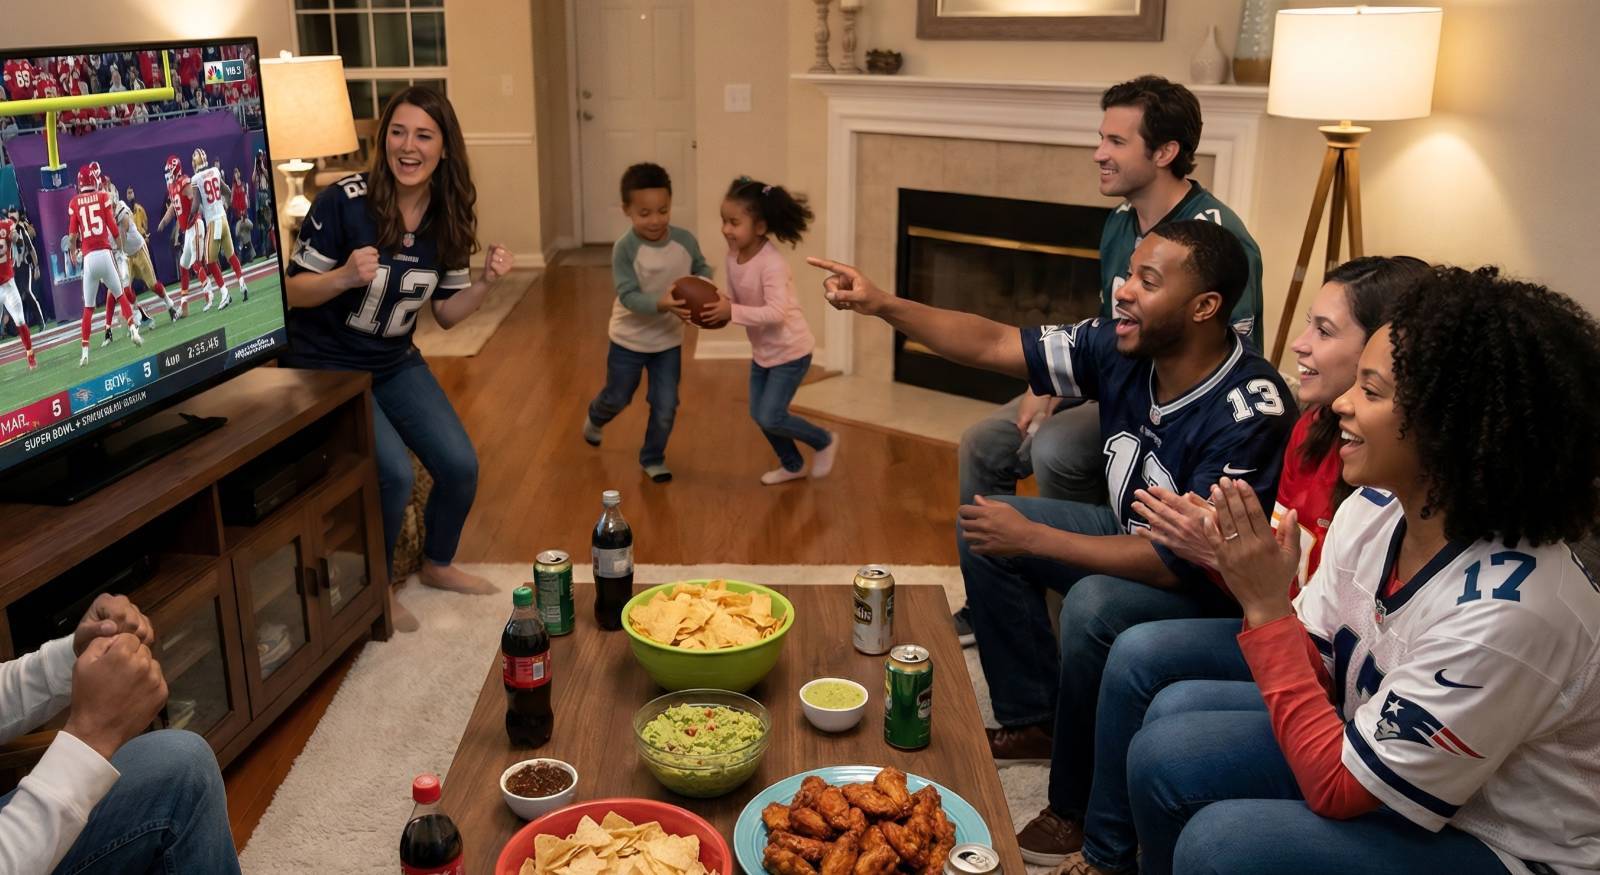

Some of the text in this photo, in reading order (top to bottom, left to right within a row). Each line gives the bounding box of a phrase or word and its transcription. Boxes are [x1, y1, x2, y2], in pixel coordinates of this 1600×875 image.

[79, 203, 104, 239] 15
[345, 264, 440, 338] 12
[52, 399, 62, 417] 5
[1227, 378, 1286, 423] 13
[24, 431, 52, 452] SUPER
[52, 422, 76, 441] BOWL
[1456, 550, 1537, 606] 17
